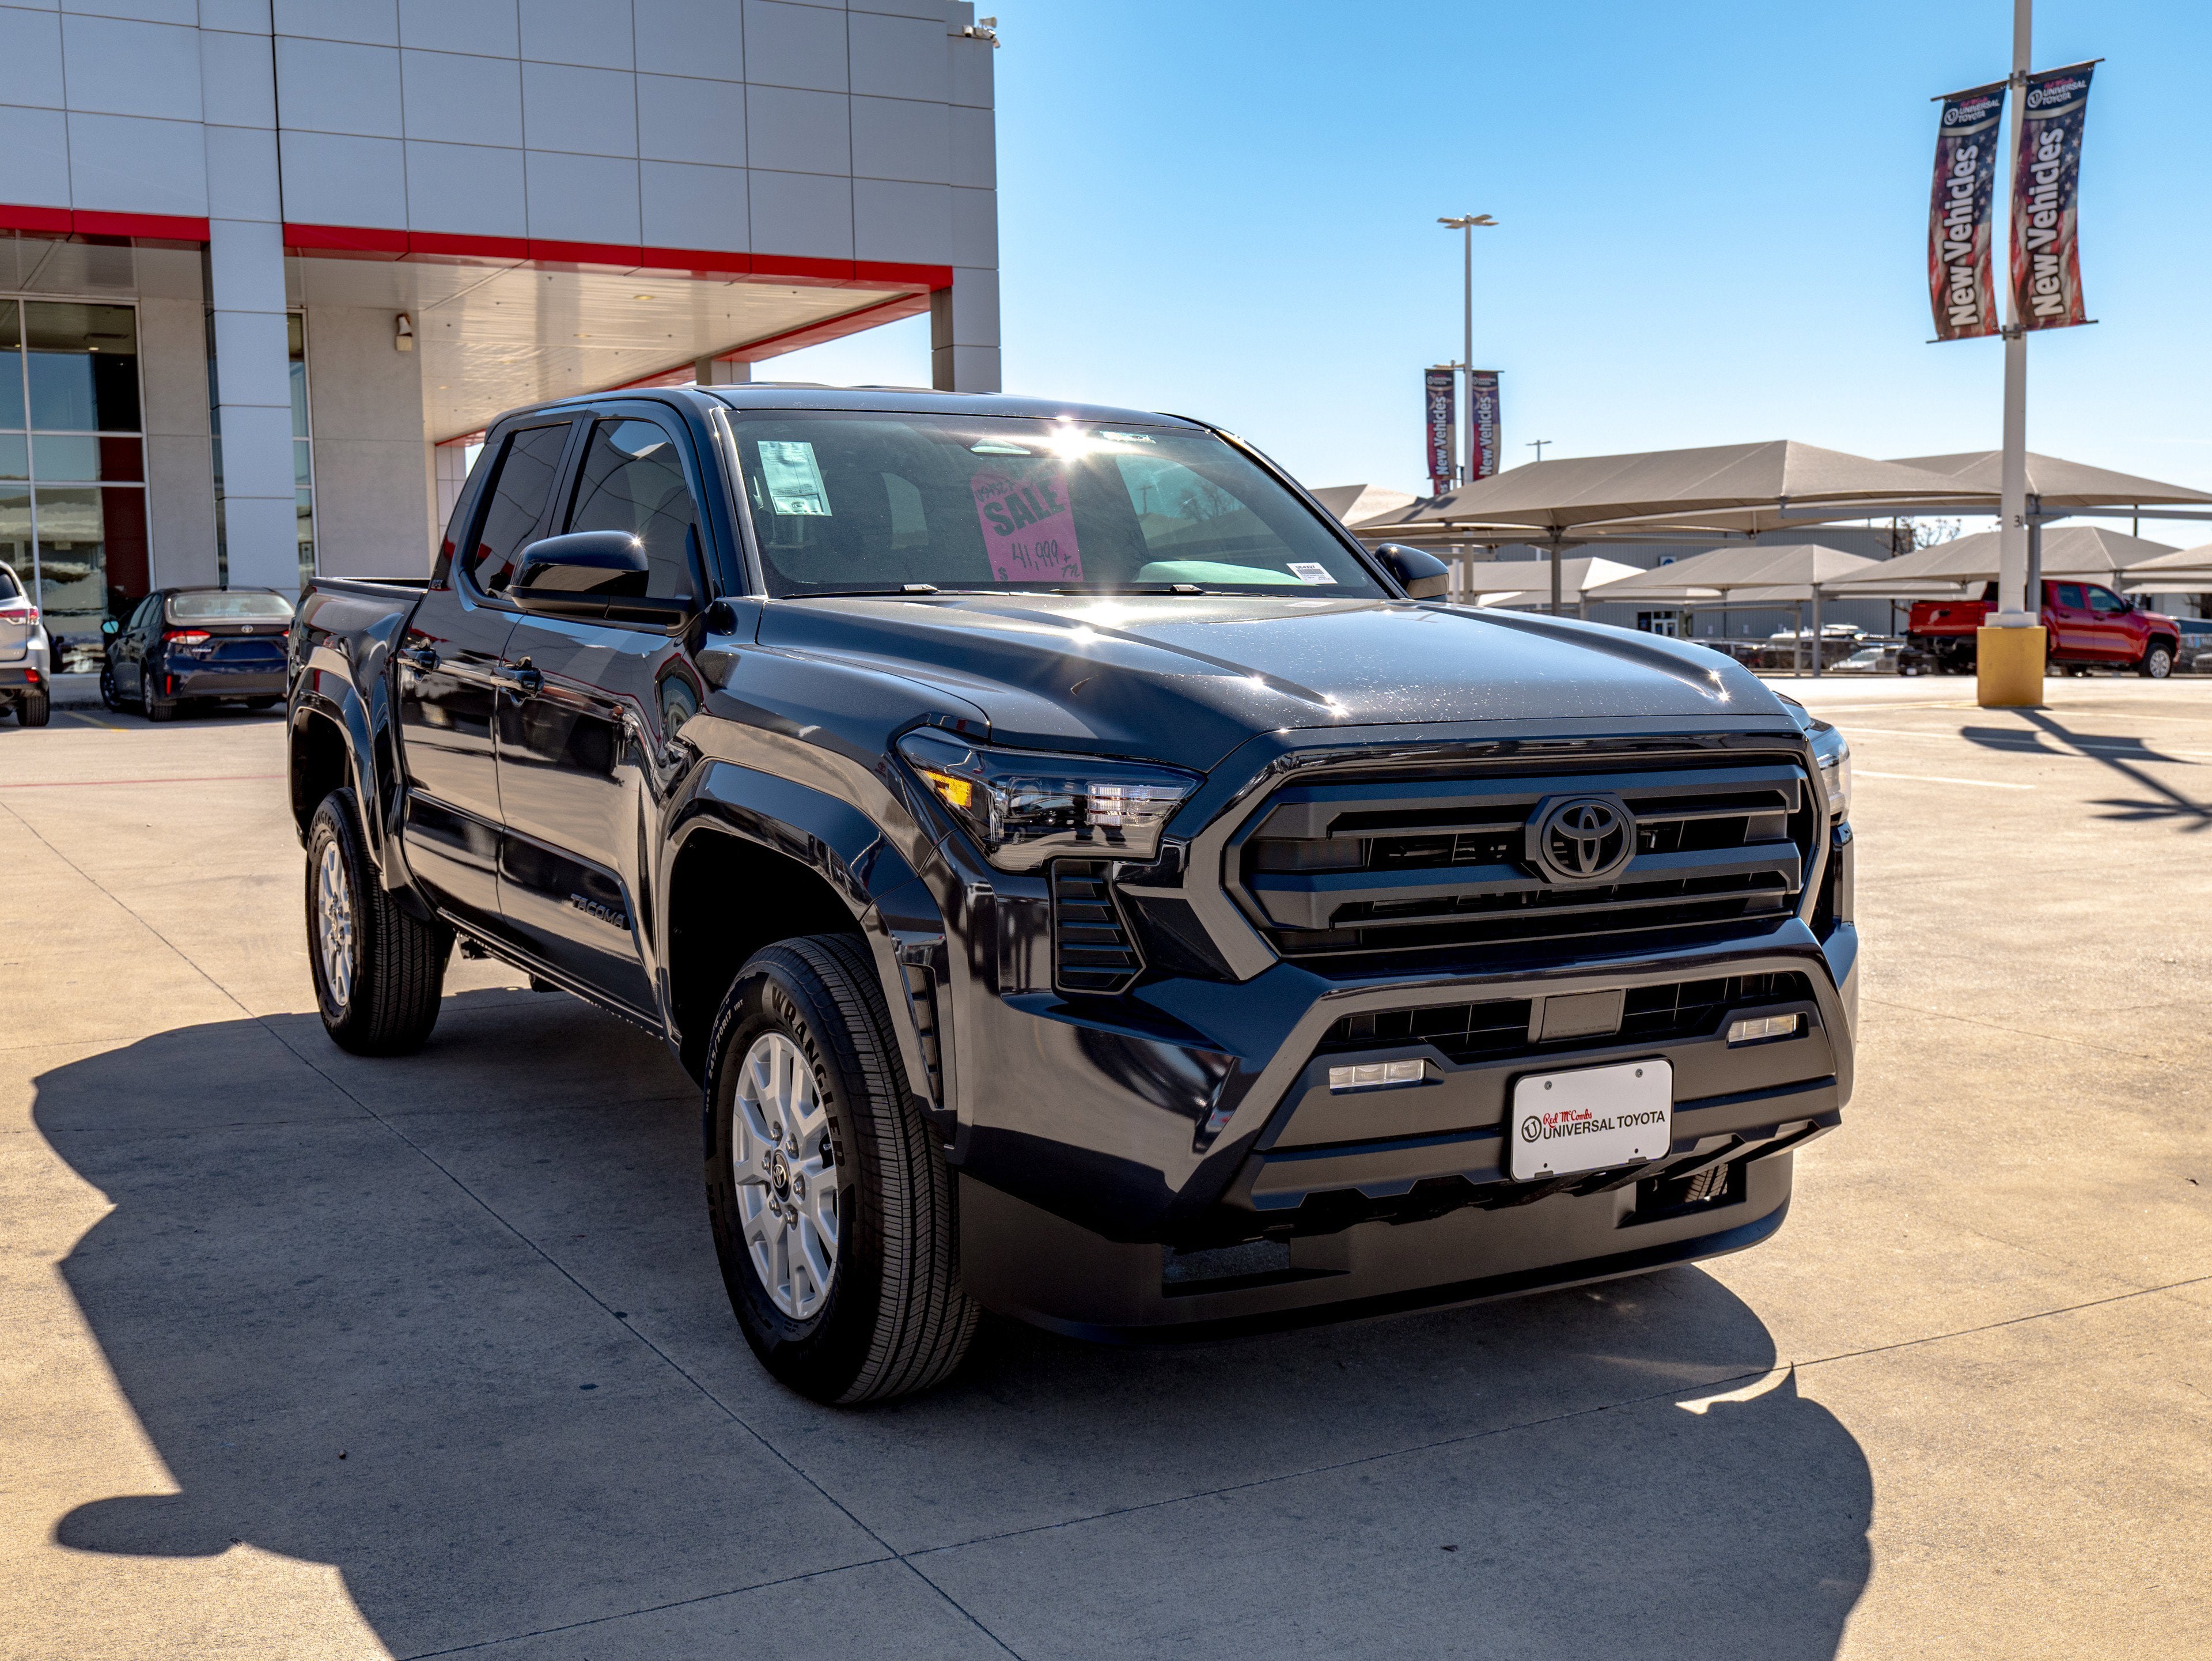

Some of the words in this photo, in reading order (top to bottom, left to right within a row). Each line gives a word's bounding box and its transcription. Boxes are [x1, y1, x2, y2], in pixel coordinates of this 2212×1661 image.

[1943, 144, 1979, 262] Vehicles
[2027, 128, 2064, 250] Vehicles
[1948, 266, 1979, 327] New
[2031, 253, 2065, 317] New
[1433, 396, 1447, 447] Vehicles
[1478, 396, 1493, 447] Vehicles
[1436, 448, 1450, 475] New
[1479, 448, 1493, 475] New
[983, 478, 1066, 536] SALE
[1011, 539, 1060, 572] 41,999
[570, 893, 625, 929] TACOMA
[772, 985, 846, 1167] WRANGLER
[1543, 1118, 1615, 1140] UNIVERSAL
[1617, 1110, 1665, 1128] TOYOTA
[1559, 1108, 1593, 1123] McCombs
